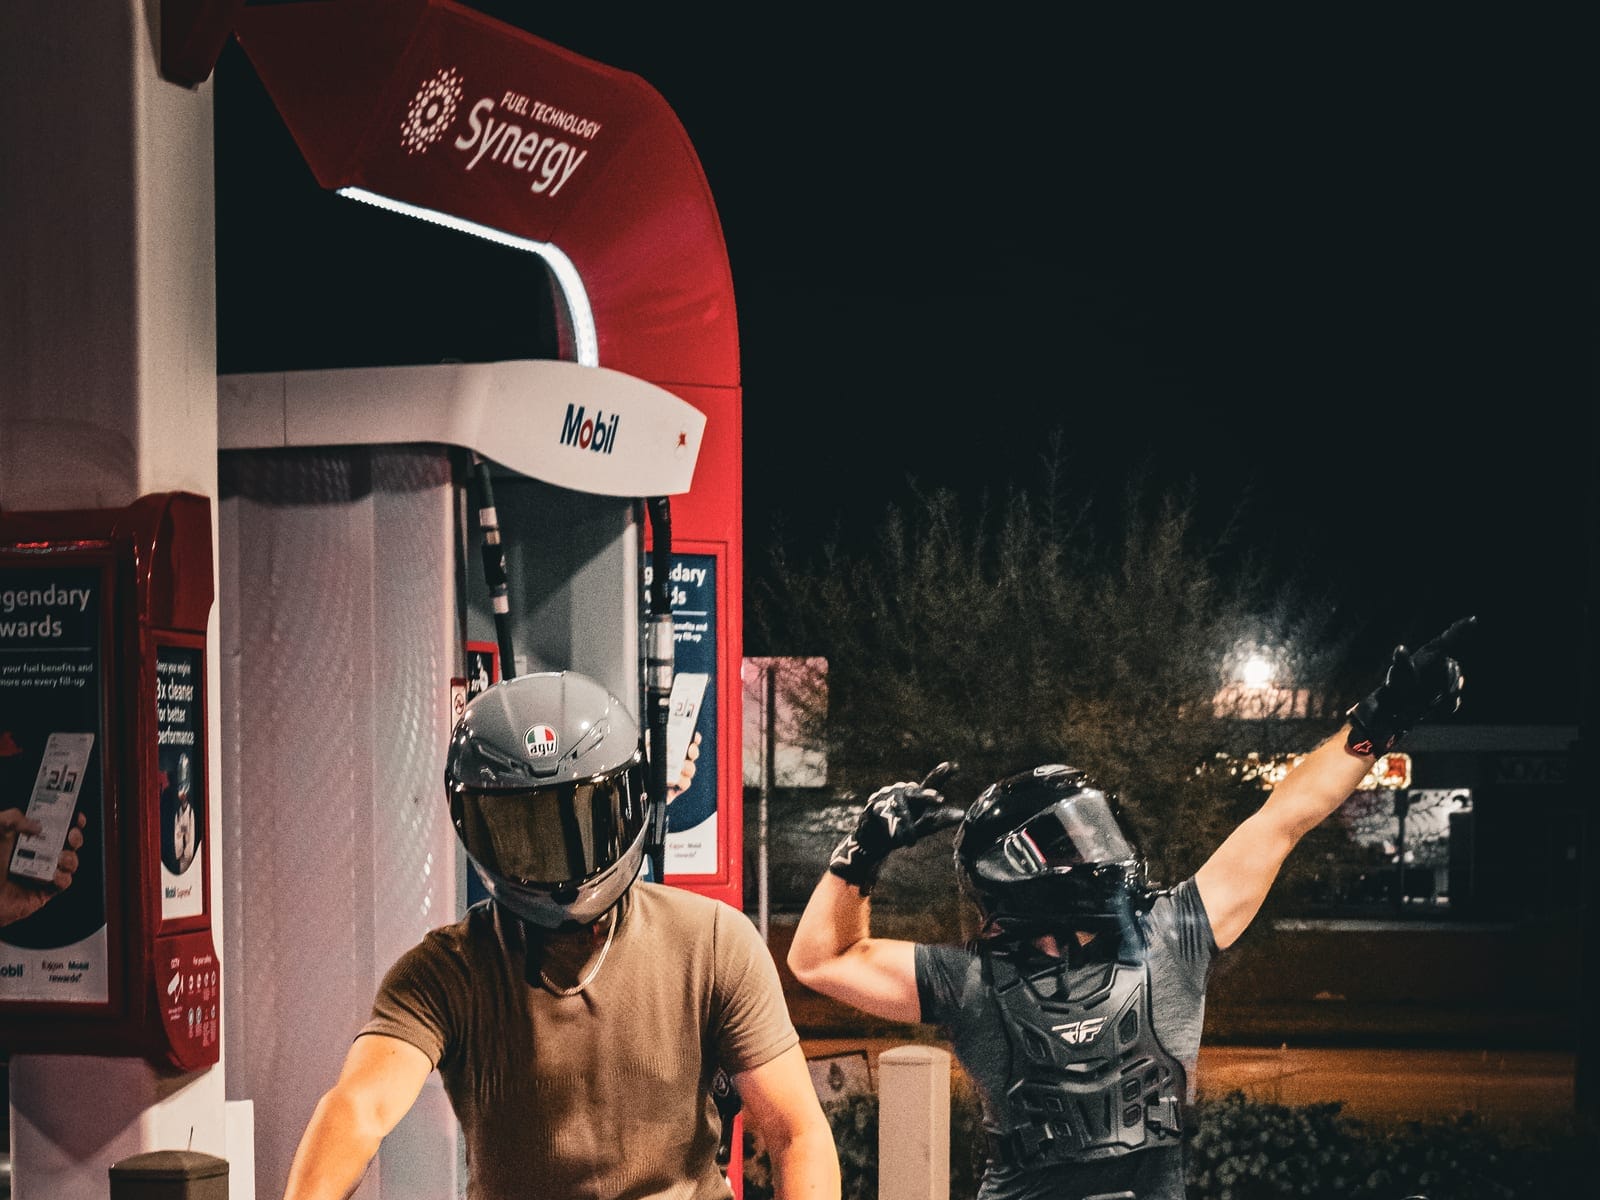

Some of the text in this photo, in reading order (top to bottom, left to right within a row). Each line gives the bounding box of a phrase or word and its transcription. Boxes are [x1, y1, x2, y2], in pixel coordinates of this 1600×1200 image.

[500, 91, 601, 139] FUEL TECHNOLOGY
[454, 98, 588, 197] Synergy
[560, 403, 620, 455] Mobil
[0, 583, 91, 613] gendary
[3, 663, 93, 675] your fuel benefits and
[34, 678, 57, 688] every
[59, 676, 86, 688] fill-up
[167, 677, 194, 702] cleaner
[167, 703, 186, 722] better
[529, 742, 555, 756] agv
